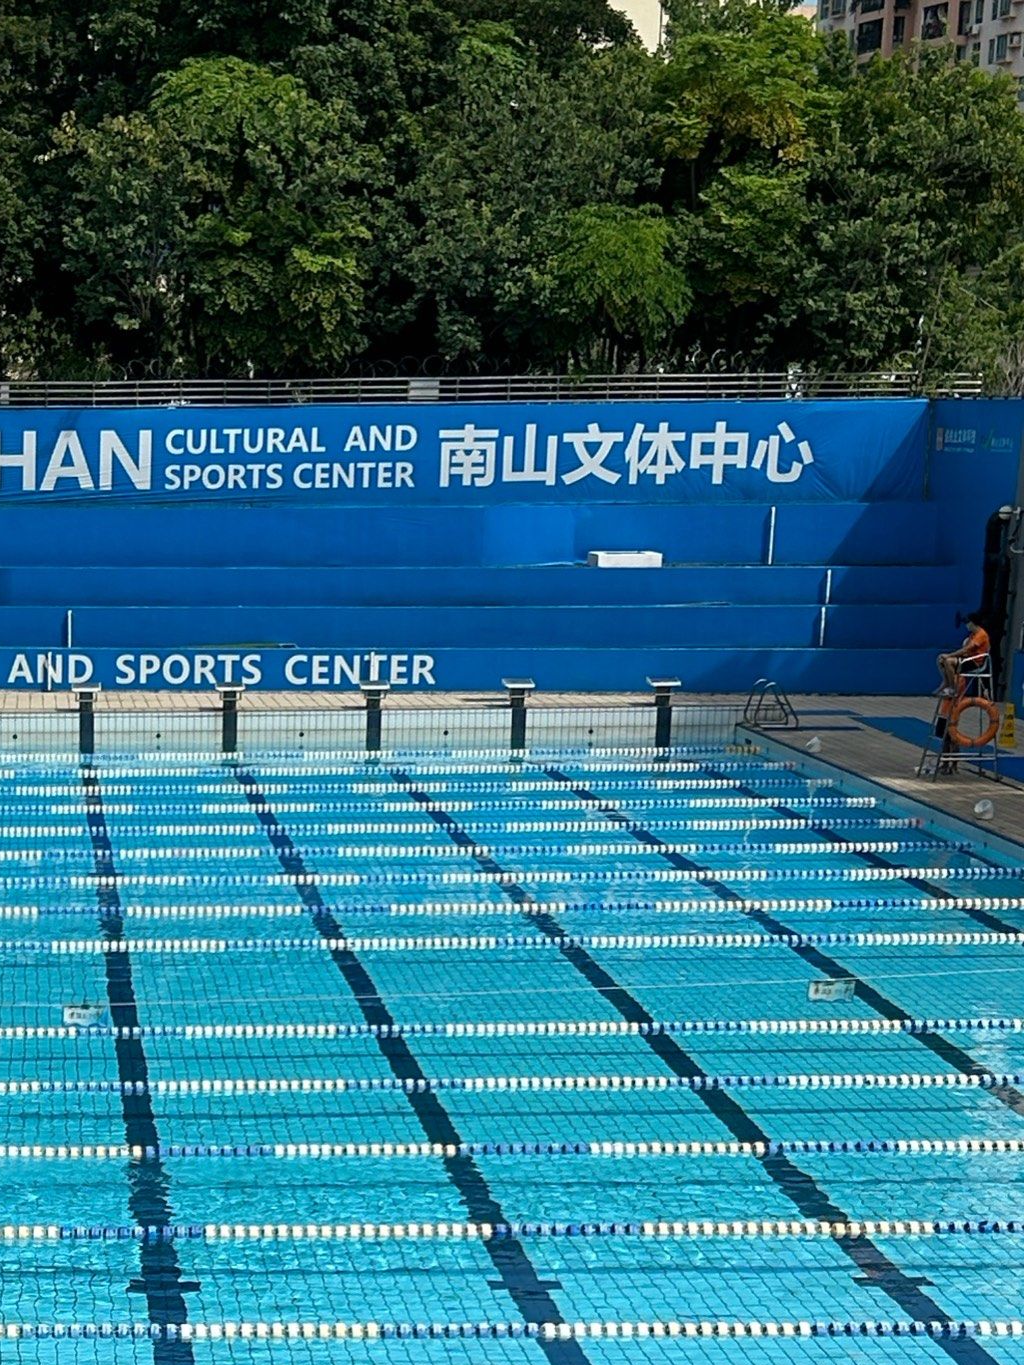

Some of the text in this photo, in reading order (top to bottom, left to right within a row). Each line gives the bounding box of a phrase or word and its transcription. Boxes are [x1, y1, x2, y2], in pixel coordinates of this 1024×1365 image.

[165, 424, 418, 455] CULTURAL AND
[438, 421, 814, 487] 南山文体中心
[165, 462, 415, 490] SPORTS CENTER
[7, 654, 94, 685] AND
[115, 654, 262, 685] SPORTS
[284, 654, 436, 685] CENTER
